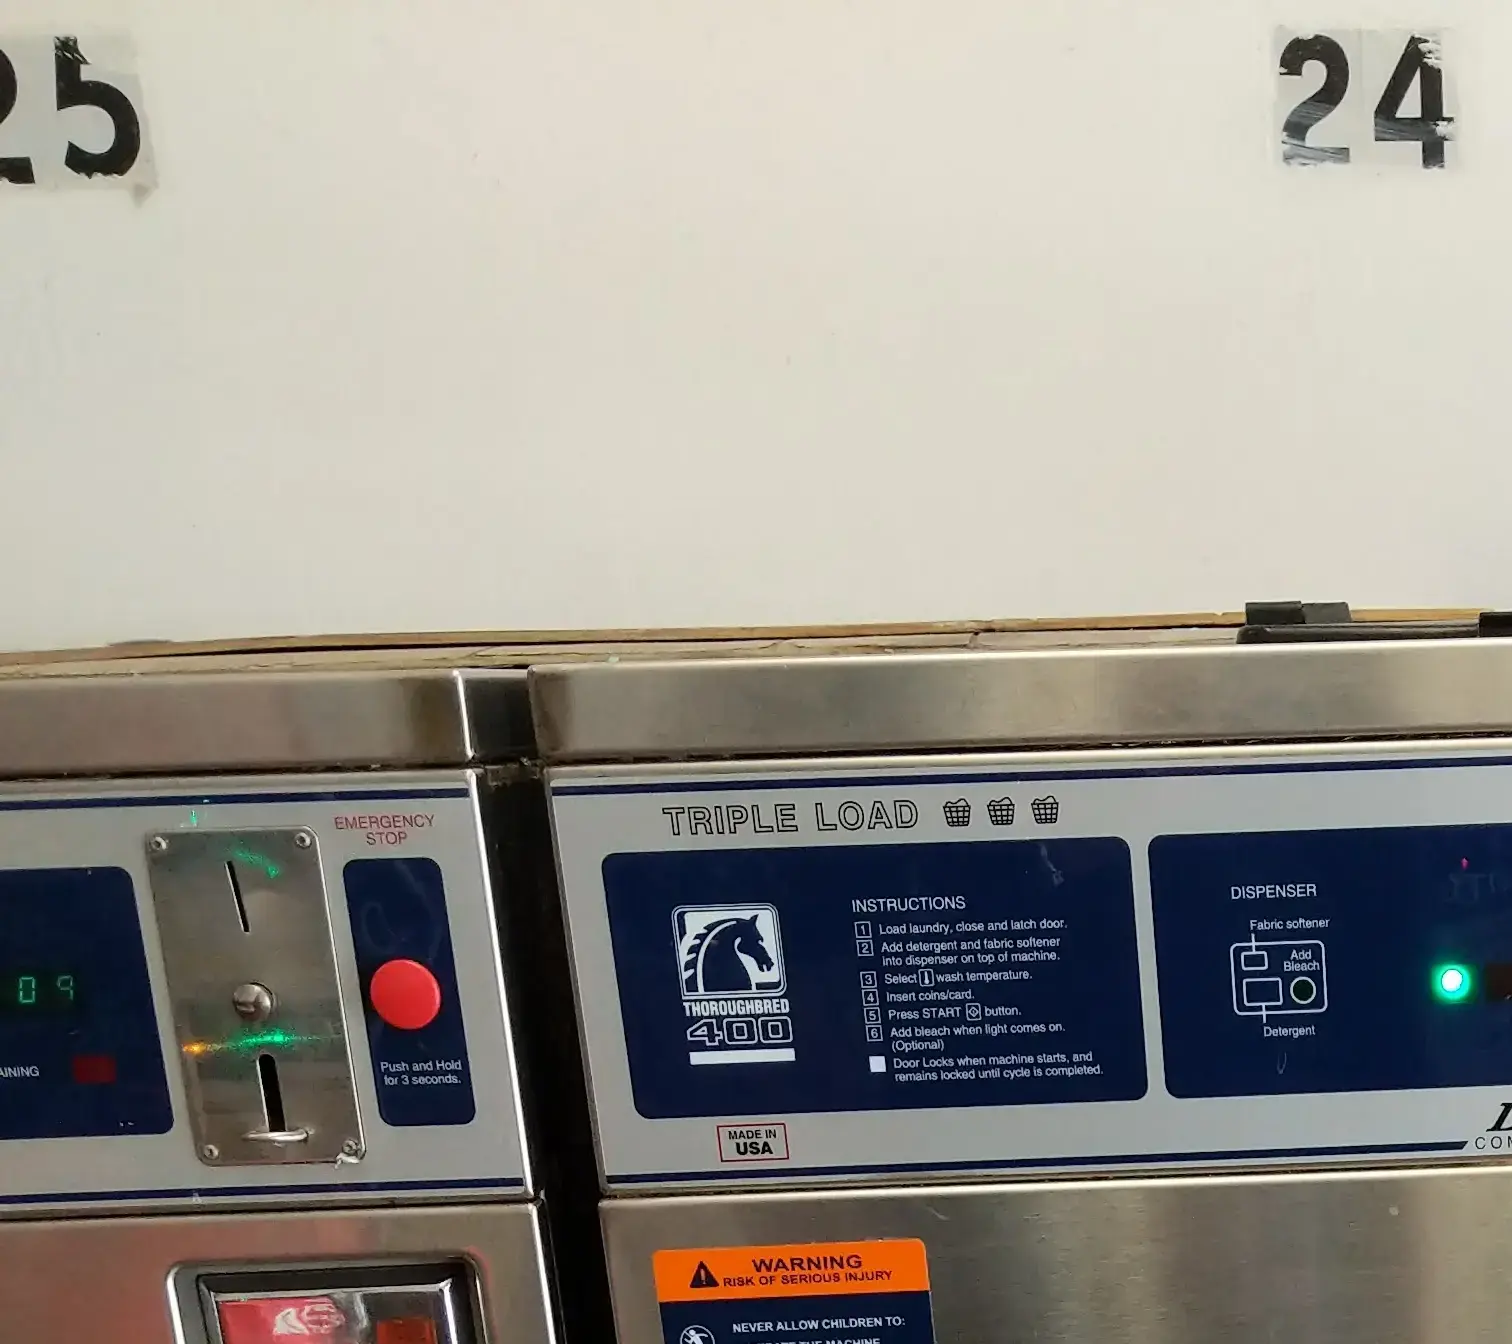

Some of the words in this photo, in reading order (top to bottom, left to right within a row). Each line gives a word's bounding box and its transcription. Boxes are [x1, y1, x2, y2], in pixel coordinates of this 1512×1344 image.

[1279, 33, 1454, 169] 24
[335, 815, 435, 829] EMERGENCY
[663, 804, 798, 836] TRIPLE
[816, 800, 918, 831] LOAD
[366, 832, 408, 845] STOP
[1231, 884, 1317, 900] DISPENSER
[851, 896, 966, 912] INSTRUCTIONS
[860, 926, 865, 935] 1
[879, 924, 906, 935] Load
[910, 922, 953, 935] laundry,
[956, 922, 984, 932] close
[988, 920, 1008, 930] and
[1011, 919, 1036, 929] latch
[1040, 918, 1068, 929] door.
[1250, 919, 1283, 930] Fabric
[1286, 918, 1330, 929] softener
[861, 943, 870, 953] 2
[881, 942, 903, 952] Add
[906, 940, 957, 953] detergent
[960, 940, 980, 949] and
[983, 937, 1014, 948] fabric
[1017, 937, 1060, 947] softener
[882, 956, 902, 966] into
[906, 954, 958, 967] dispenser
[961, 955, 975, 963] on
[977, 954, 994, 964] top
[998, 953, 1008, 962] of
[1011, 950, 1060, 962] machine.
[1290, 949, 1312, 960] Add
[1284, 960, 1320, 972] Bleach
[865, 975, 872, 984] 3
[885, 974, 917, 984] Select
[936, 971, 963, 982] wash
[966, 970, 1032, 983] temperature.
[867, 992, 875, 1003] 4
[886, 992, 916, 1002] Insert
[919, 989, 974, 1000] coins/card.
[683, 999, 790, 1016] THOROUGHBRED
[869, 1011, 876, 1020] 5
[888, 1010, 919, 1020] Press
[923, 1007, 961, 1018] START
[984, 1006, 1021, 1017] button.
[687, 1016, 793, 1046] 400
[871, 1028, 878, 1038] 6
[890, 1027, 912, 1037] Add
[915, 1026, 949, 1036] bleach
[953, 1025, 982, 1035] when
[985, 1024, 1007, 1035] light
[1011, 1022, 1046, 1033] comes
[1049, 1022, 1065, 1032] on.
[1264, 1025, 1315, 1038] Detergent
[892, 1040, 944, 1052] (Optional)
[381, 1062, 408, 1074] Push
[412, 1062, 433, 1072] and
[435, 1059, 462, 1072] Hold
[894, 1058, 920, 1068] Door
[923, 1057, 954, 1068] Locks
[957, 1055, 985, 1066] when
[989, 1054, 1034, 1065] machine
[1037, 1053, 1069, 1064] starts,
[1072, 1052, 1092, 1062] and
[384, 1075, 398, 1085] for
[402, 1075, 408, 1085] 3
[412, 1074, 462, 1085] seconds.
[895, 1071, 938, 1082] remains
[941, 1069, 975, 1081] locked
[978, 1068, 1000, 1078] until
[1003, 1067, 1030, 1079] cycle
[1033, 1066, 1043, 1076] is
[1047, 1064, 1103, 1078] completed.
[728, 1130, 761, 1140] MADE
[766, 1129, 776, 1138] IN
[736, 1141, 773, 1155] USA
[752, 1254, 862, 1272] WARNING
[723, 1277, 756, 1287] RISK
[759, 1275, 776, 1285] OF
[782, 1272, 840, 1285] SERIOUS
[845, 1270, 892, 1282] INJURY
[732, 1321, 774, 1332] NEVER
[776, 1320, 819, 1331] ALLOW
[822, 1318, 882, 1329] CHILDREN
[885, 1316, 904, 1326] TO:
